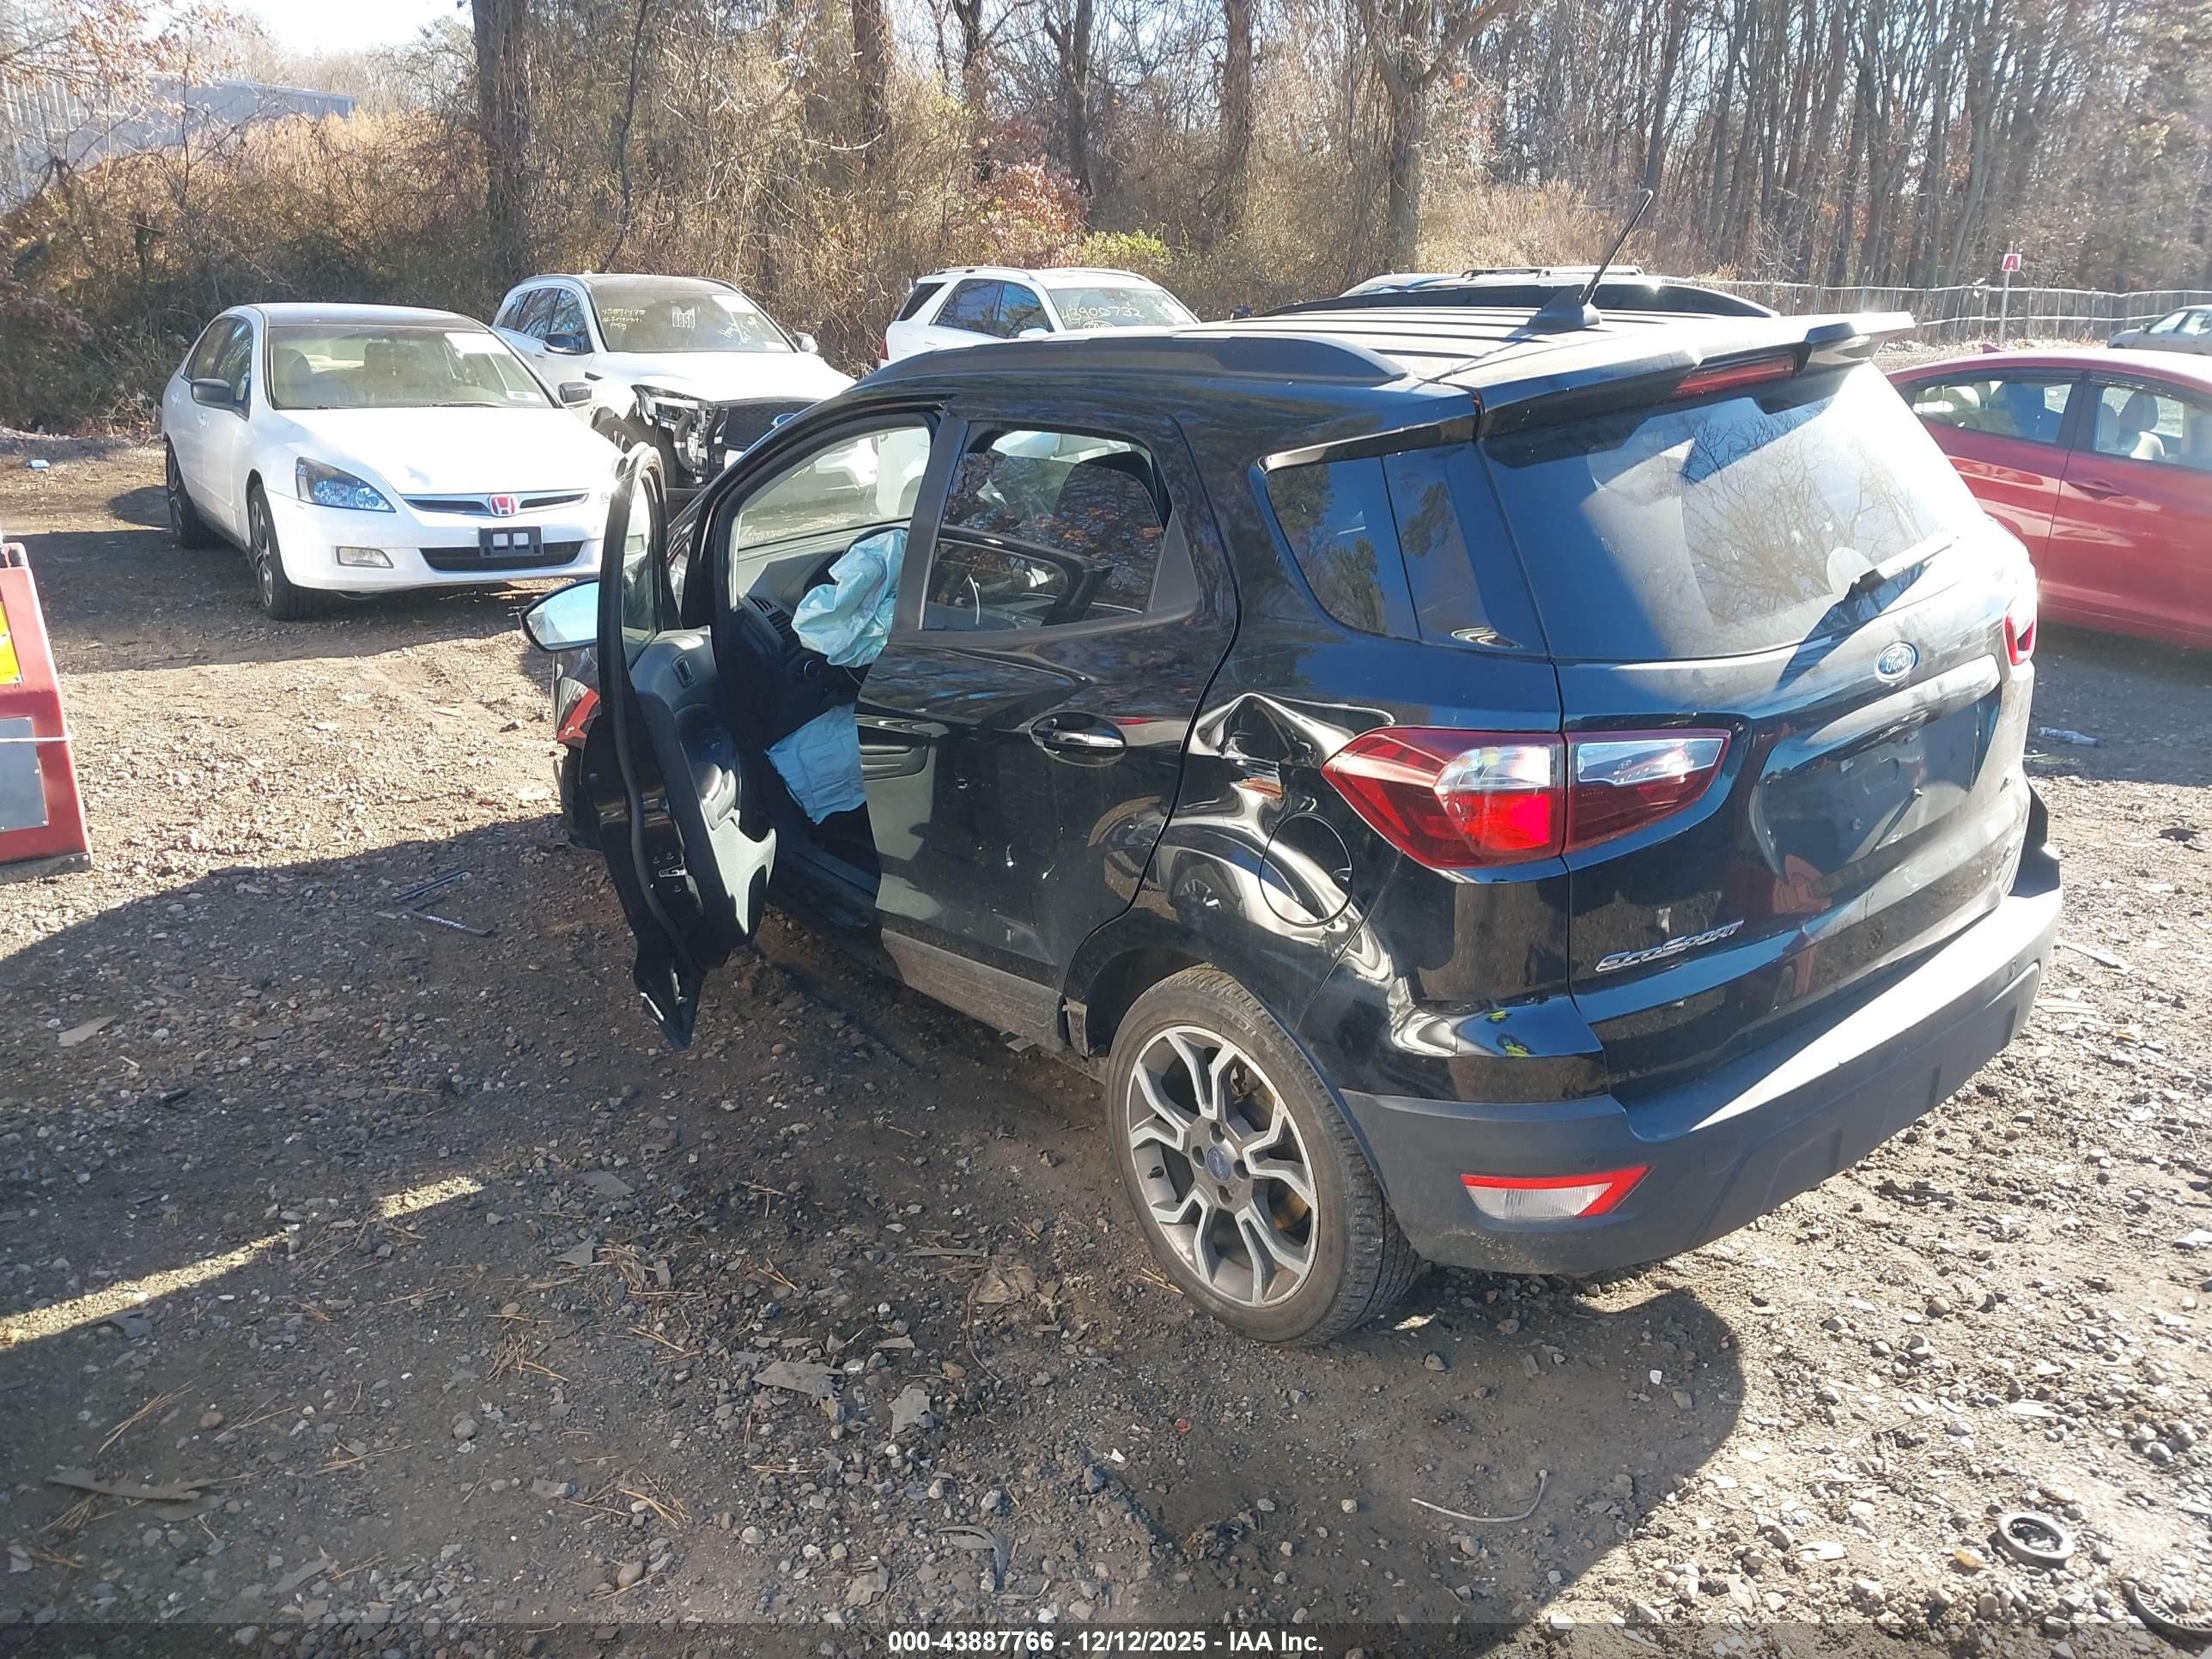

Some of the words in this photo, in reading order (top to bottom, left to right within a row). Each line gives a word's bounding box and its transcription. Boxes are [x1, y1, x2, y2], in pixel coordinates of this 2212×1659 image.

[2002, 255, 2020, 270] A
[1061, 306, 1146, 325] 43900732
[1885, 648, 1910, 674] Ford
